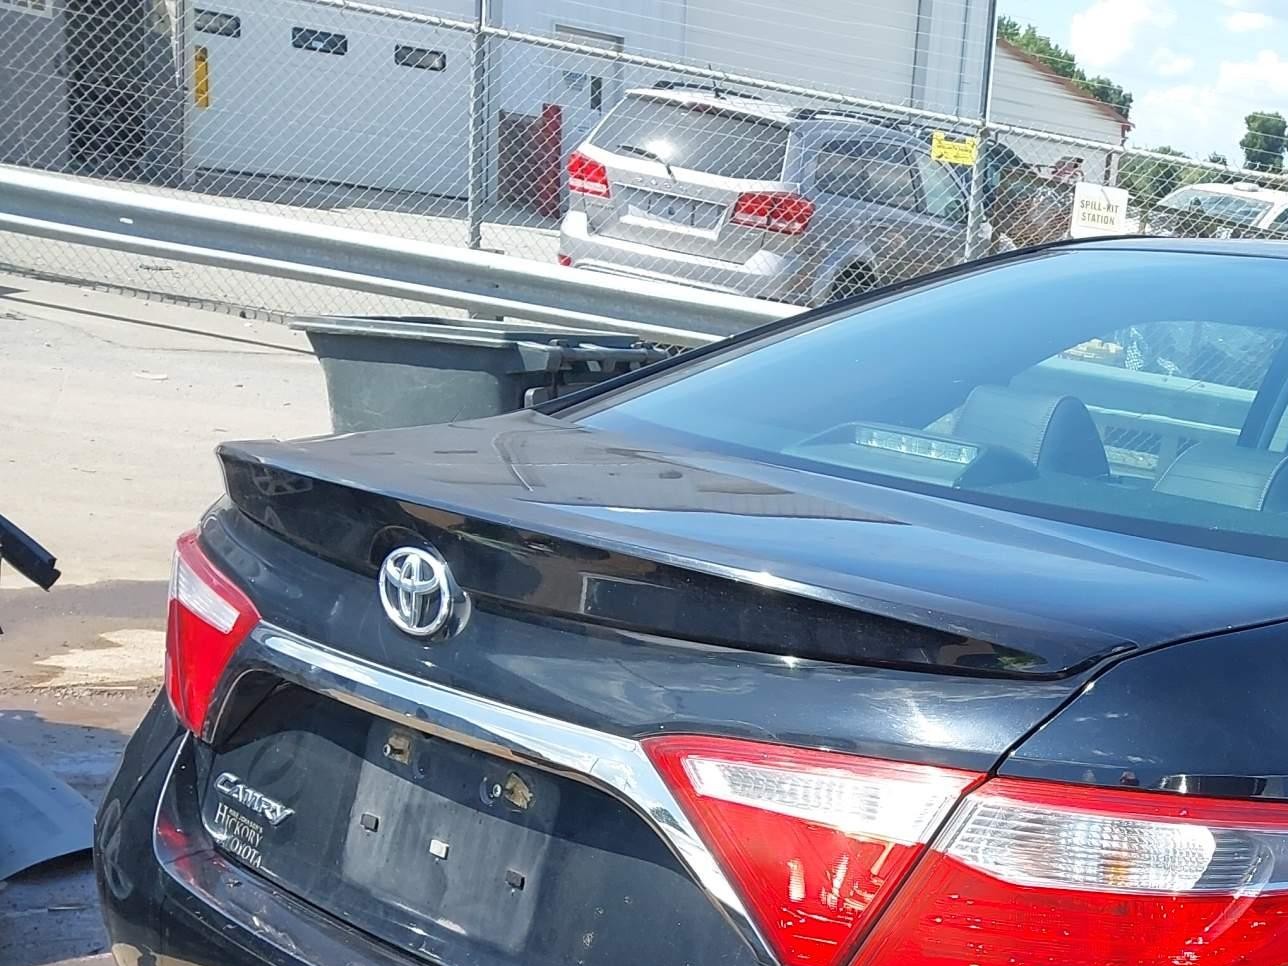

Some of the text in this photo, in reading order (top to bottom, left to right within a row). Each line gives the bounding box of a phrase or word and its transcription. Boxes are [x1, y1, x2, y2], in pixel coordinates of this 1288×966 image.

[1080, 199, 1120, 213] SPILL-KIT
[1081, 212, 1115, 225] STATION
[214, 772, 295, 826] CAMRY
[214, 802, 263, 848] HICKORY
